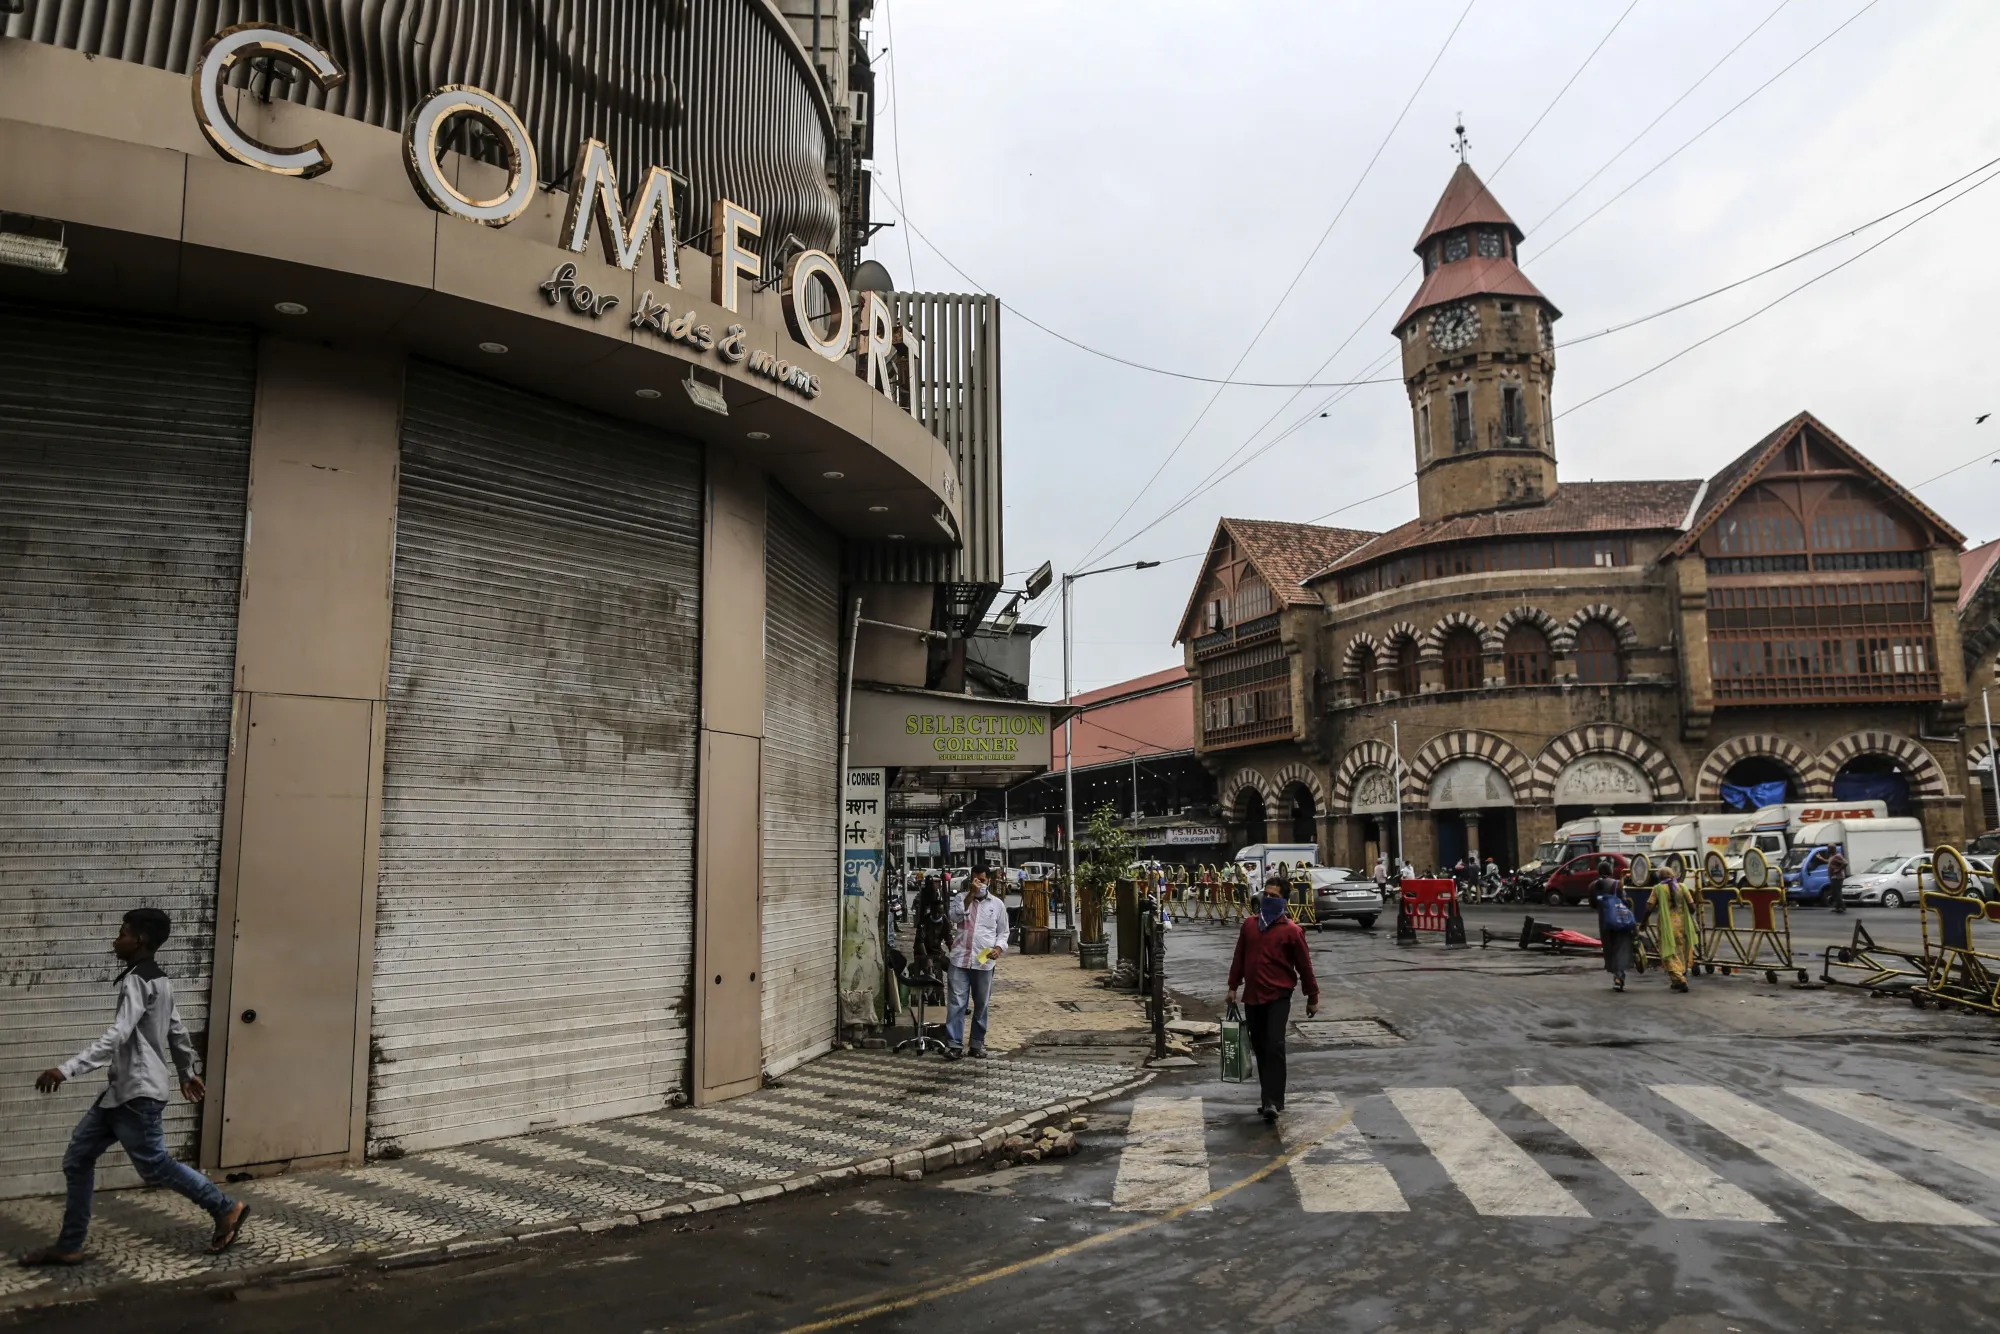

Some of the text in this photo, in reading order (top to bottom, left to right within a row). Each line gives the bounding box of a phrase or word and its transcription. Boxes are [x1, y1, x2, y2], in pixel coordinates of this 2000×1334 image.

[192, 22, 920, 420] COMFORT
[540, 261, 822, 400] for kids & moms
[906, 715, 1045, 735] SELECTION
[933, 737, 1019, 752] CORNER
[851, 772, 880, 786] CORNER
